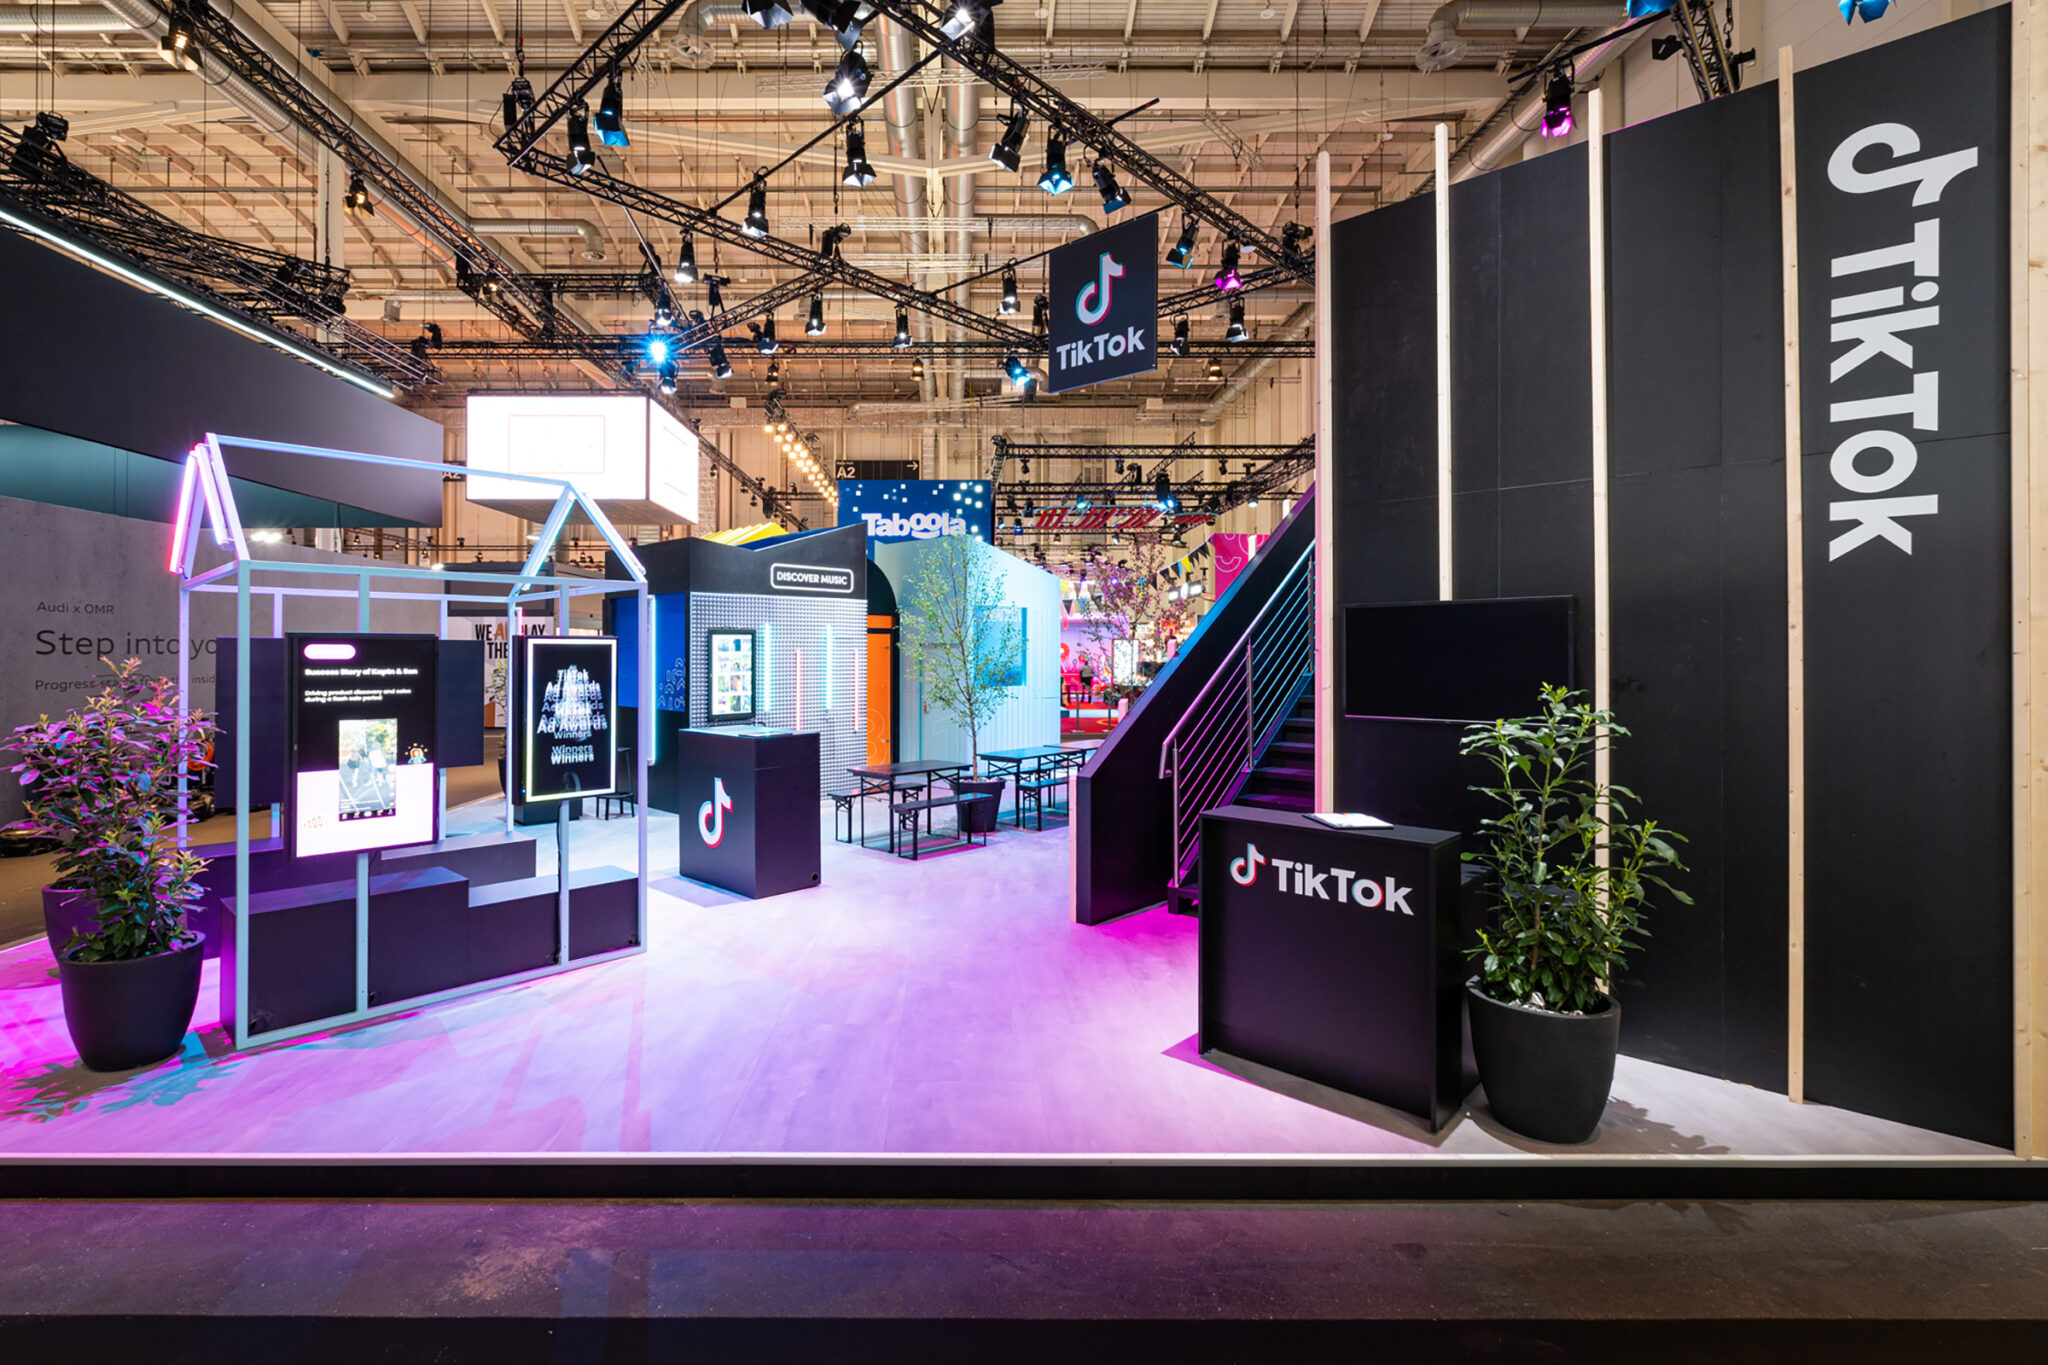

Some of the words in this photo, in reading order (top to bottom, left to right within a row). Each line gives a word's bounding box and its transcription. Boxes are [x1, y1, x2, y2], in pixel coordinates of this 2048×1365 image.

[1056, 326, 1146, 370] TikTok
[1829, 217, 1939, 562] TikTok
[836, 466, 856, 479] A2
[861, 512, 966, 538] Taboola
[776, 571, 820, 584] DISCOVER
[820, 574, 848, 586] MUSIC
[36, 601, 69, 613] Audi
[73, 606, 81, 614] x
[84, 604, 114, 615] OMR
[475, 624, 493, 641] WE
[35, 630, 115, 661] Step
[126, 632, 180, 656] into
[35, 680, 96, 693] Progress
[1271, 858, 1414, 916] TikTok
